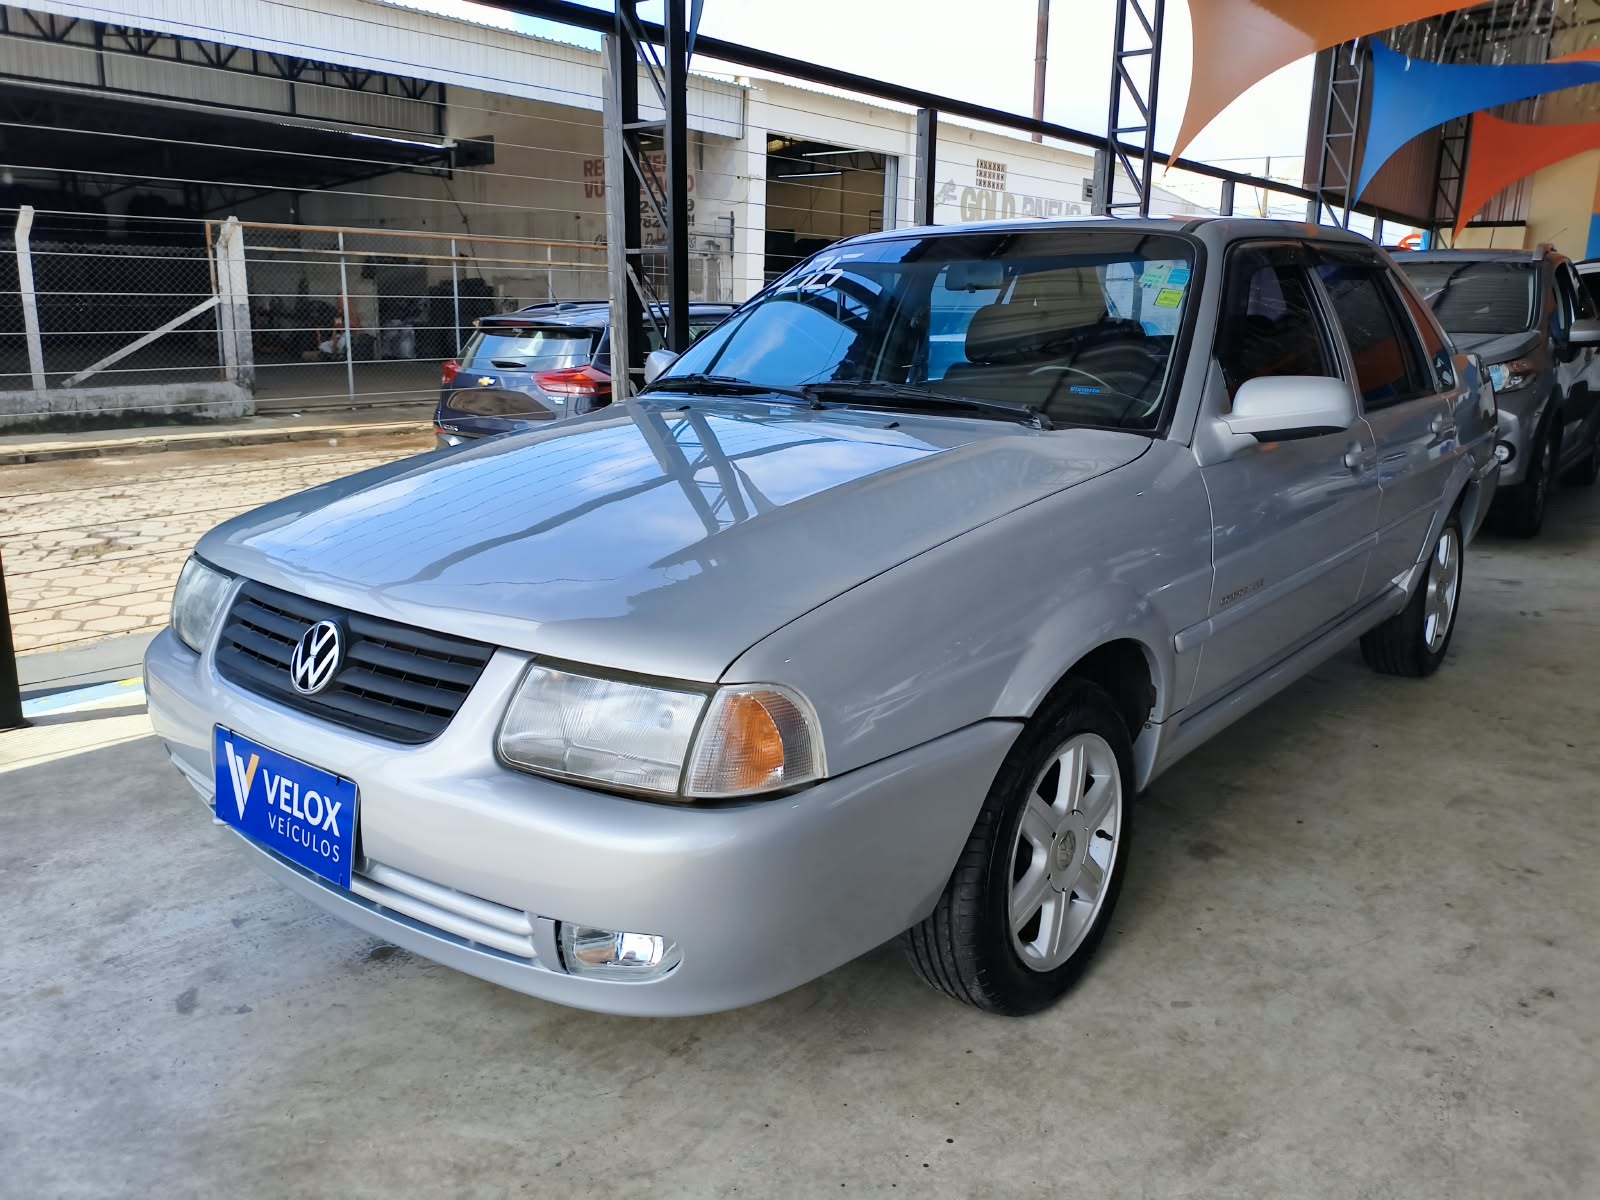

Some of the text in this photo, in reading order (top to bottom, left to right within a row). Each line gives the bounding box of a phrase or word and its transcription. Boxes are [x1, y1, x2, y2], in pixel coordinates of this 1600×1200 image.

[960, 187, 1016, 222] GOLD
[263, 768, 343, 837] VELOX
[268, 811, 340, 863] VEÍCULOS
